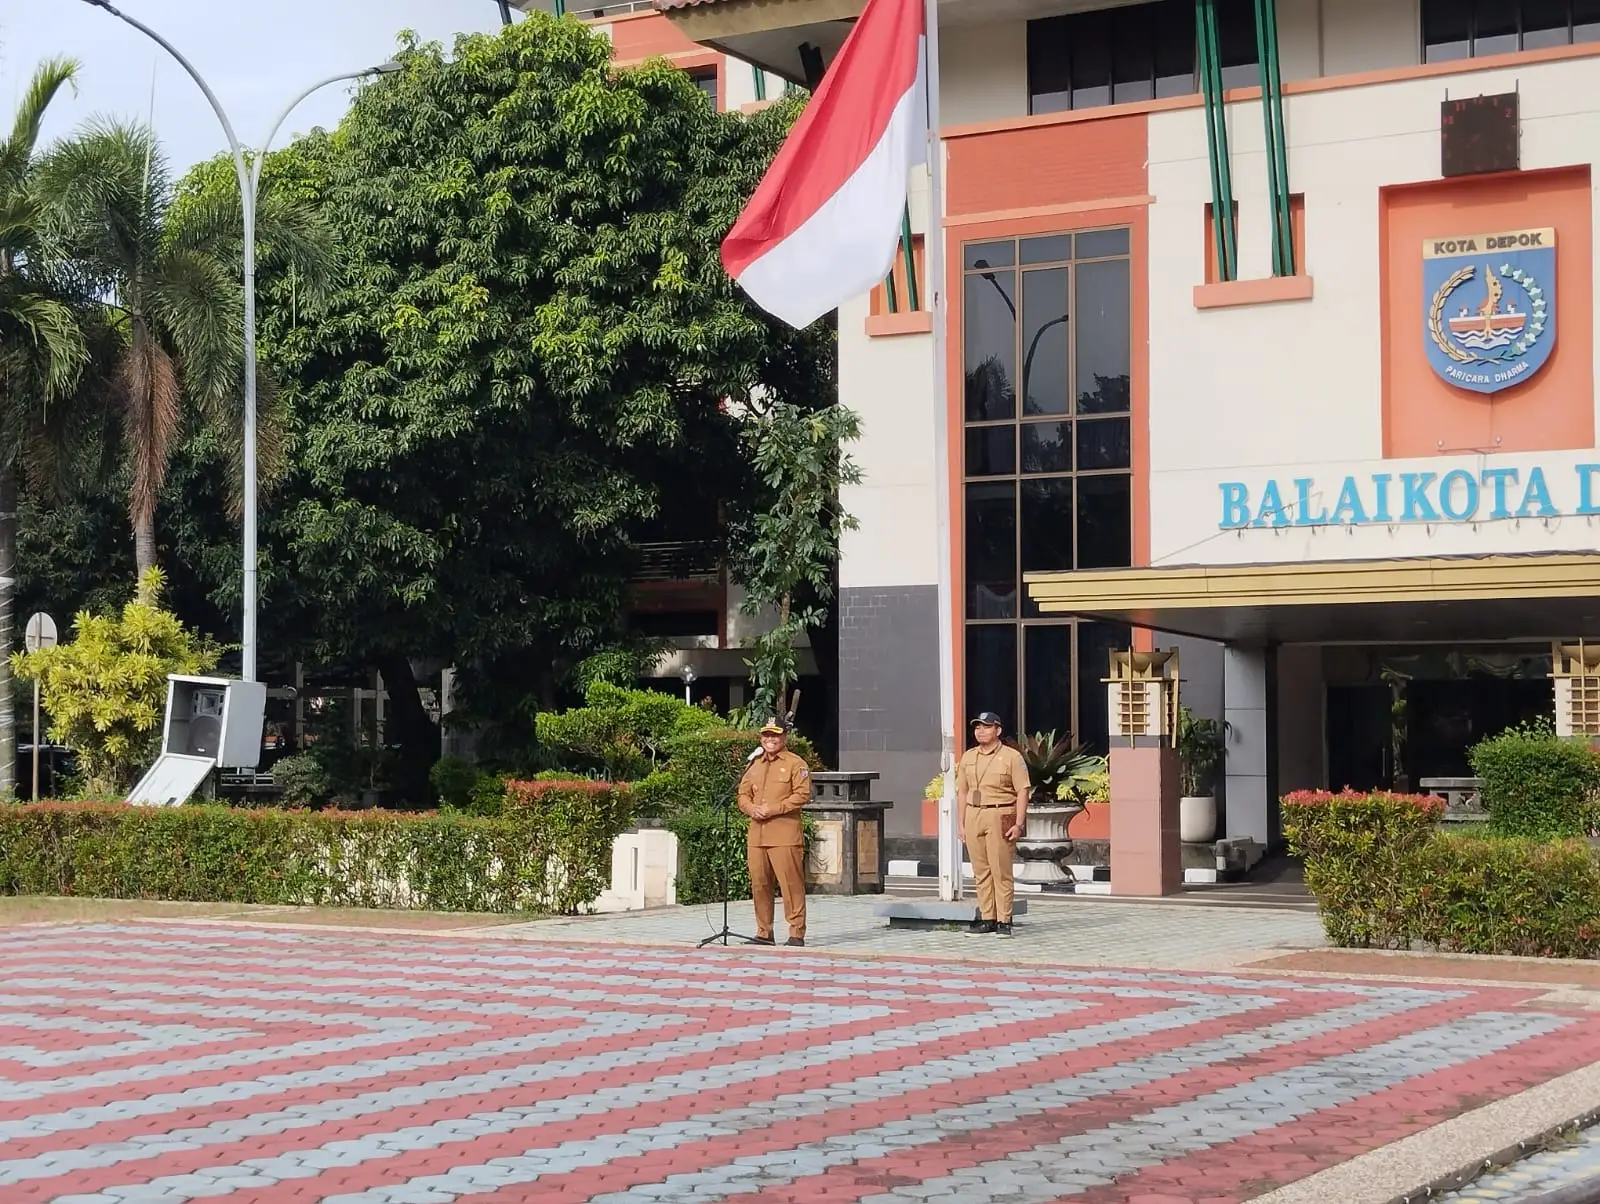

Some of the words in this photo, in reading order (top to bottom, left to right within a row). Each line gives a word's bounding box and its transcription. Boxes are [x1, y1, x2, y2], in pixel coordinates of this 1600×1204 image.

[1434, 239, 1477, 255] KOTA
[1486, 233, 1543, 250] DEPOK
[1444, 366, 1490, 384] PARICARA
[1495, 362, 1529, 383] DHARMA
[1218, 466, 1558, 530] BALAIKOTA
